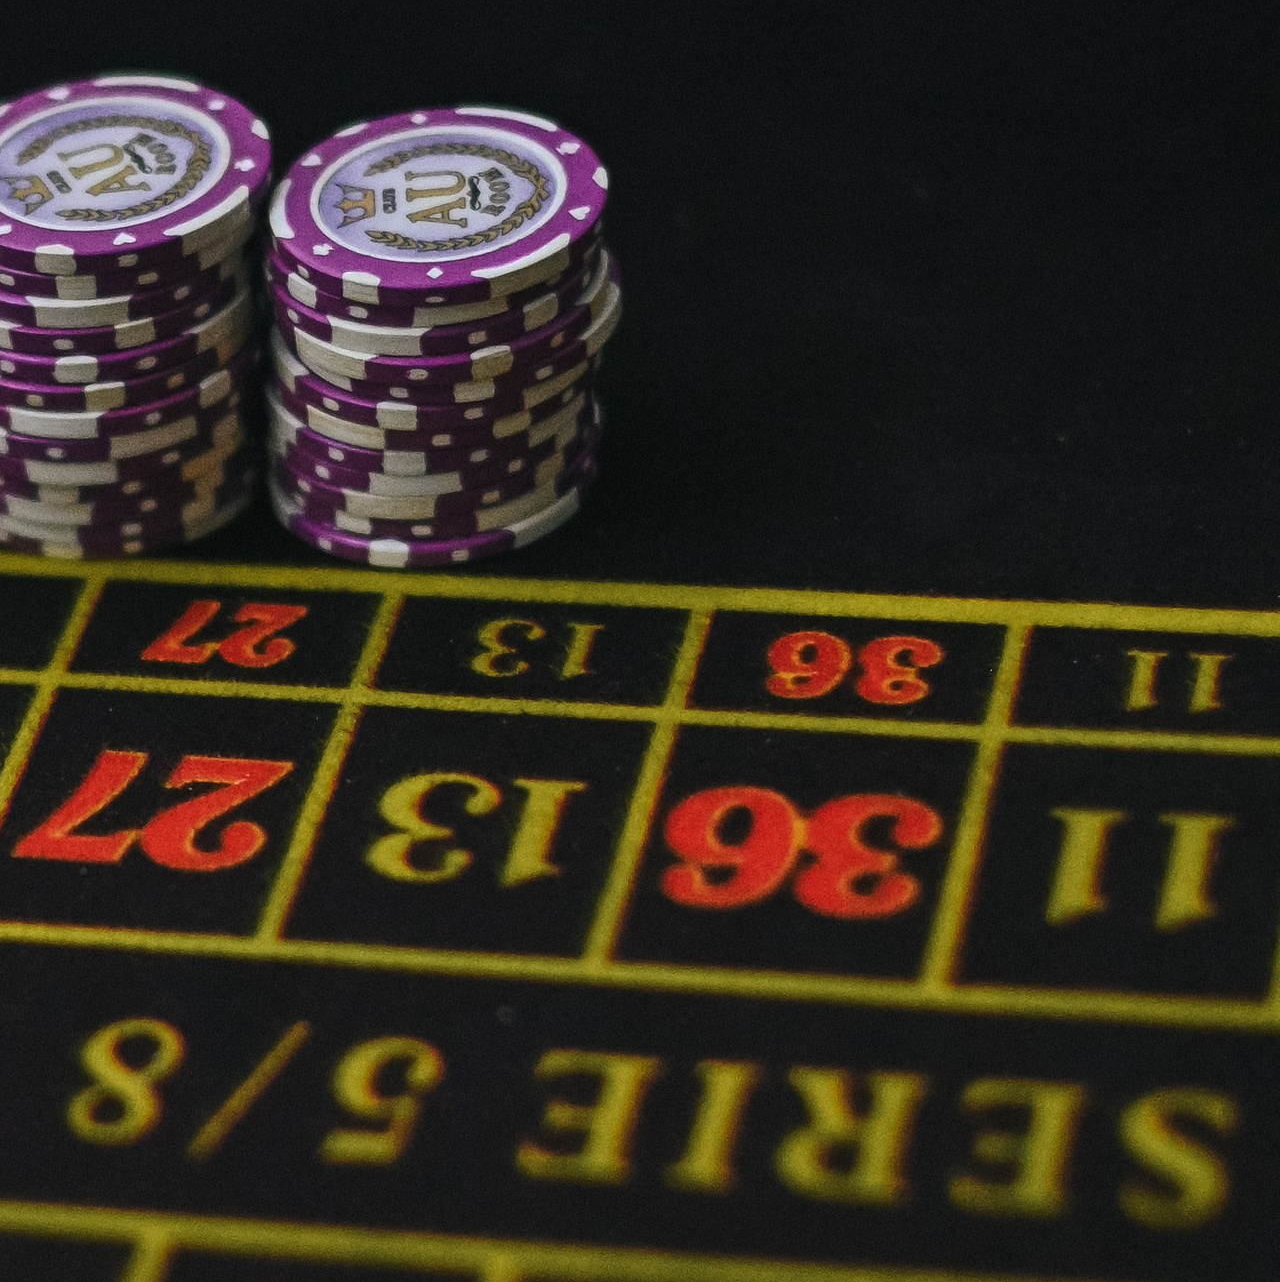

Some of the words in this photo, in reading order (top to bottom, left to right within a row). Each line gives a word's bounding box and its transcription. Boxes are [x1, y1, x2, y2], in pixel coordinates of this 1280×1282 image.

[56, 143, 152, 197] AU
[404, 170, 468, 229] AU
[140, 599, 309, 668] 27
[471, 617, 604, 680] 13
[766, 629, 945, 706] 36
[1125, 648, 1233, 714] 11
[11, 747, 295, 873] 27
[364, 770, 592, 889] 13
[659, 784, 945, 920] 36
[1044, 806, 1239, 933] 11
[516, 1047, 1243, 1232] SERIE
